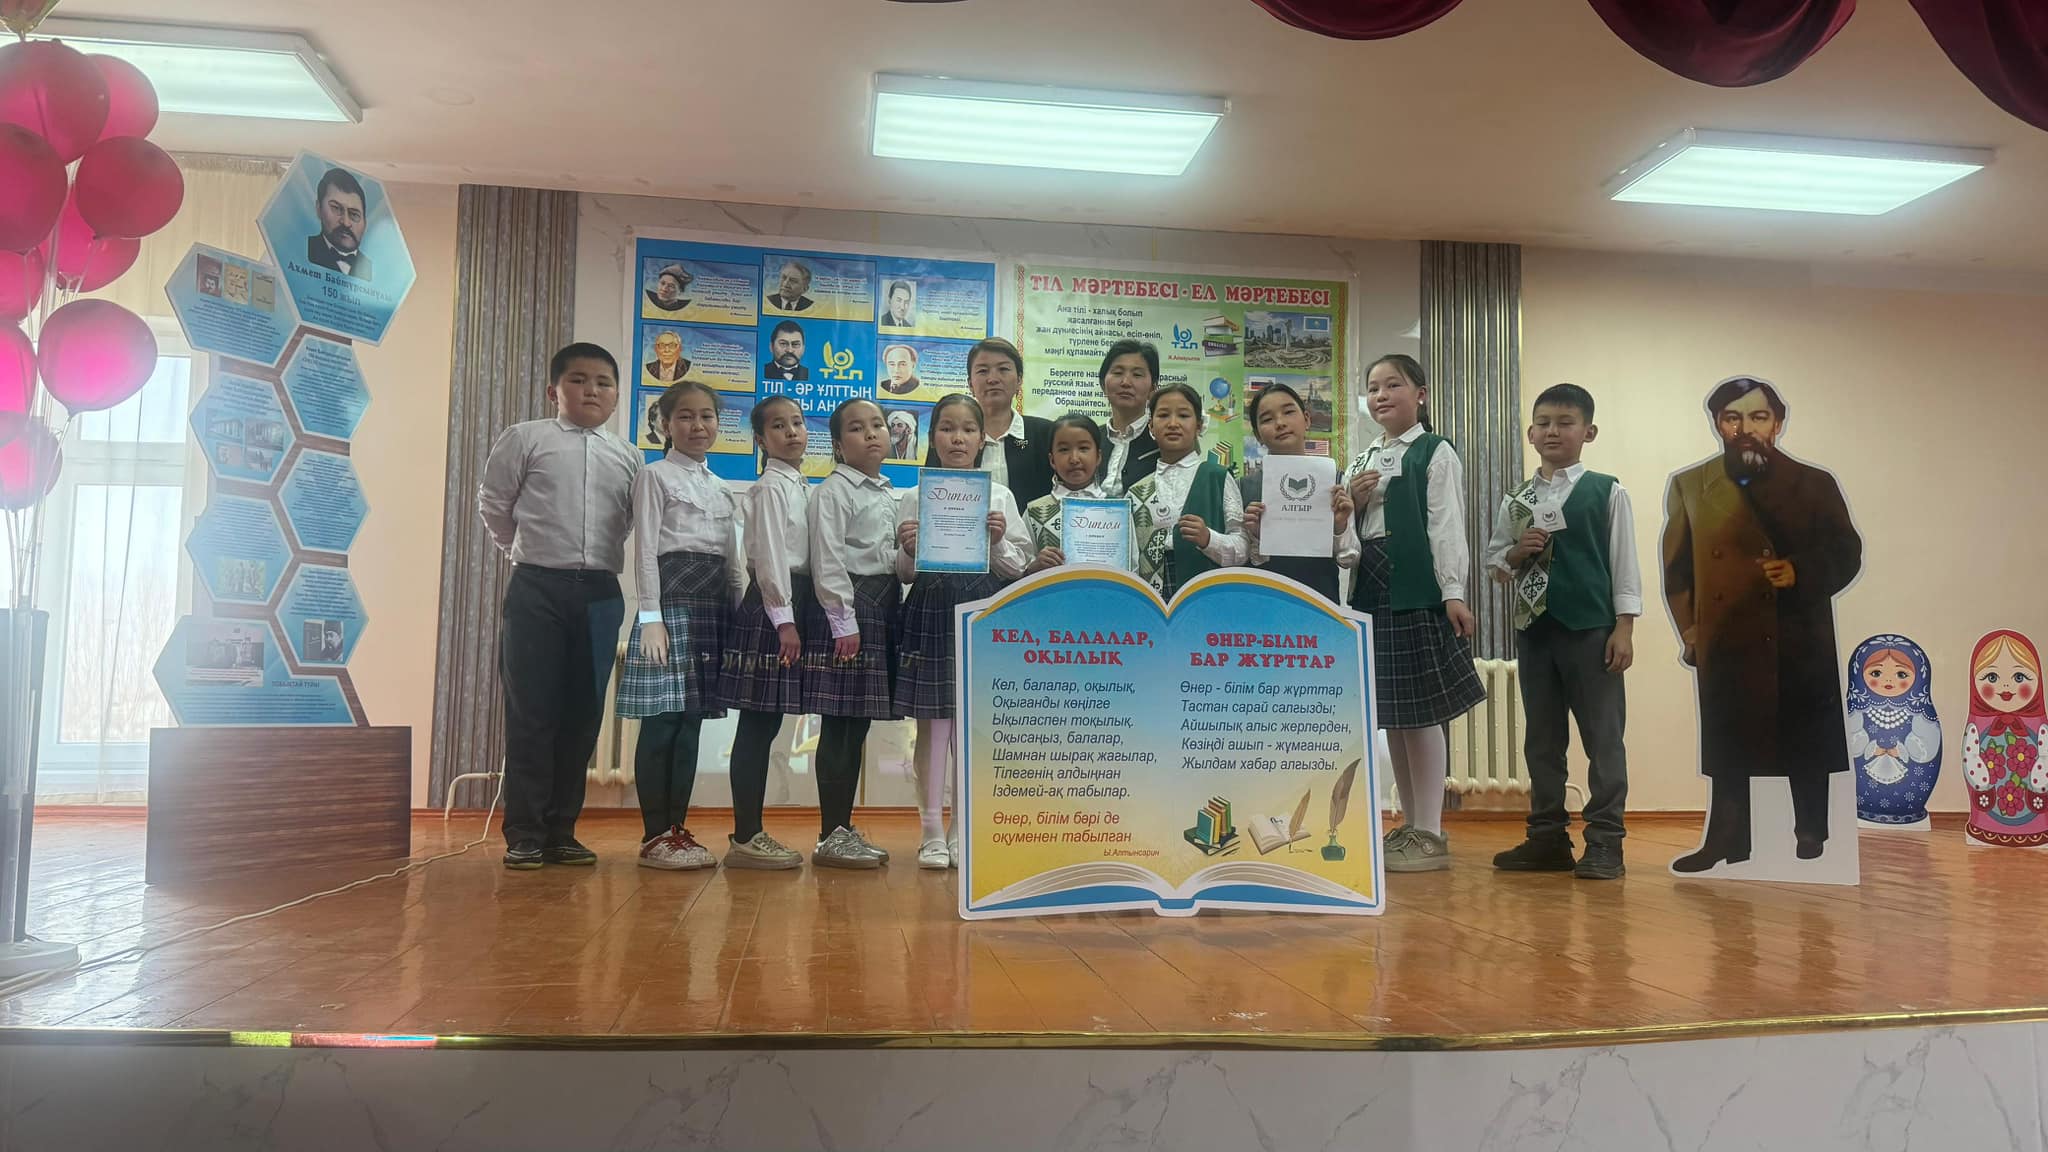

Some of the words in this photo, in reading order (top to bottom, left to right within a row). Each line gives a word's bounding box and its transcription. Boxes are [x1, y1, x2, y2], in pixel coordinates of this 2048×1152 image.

[288, 261, 321, 279] Ахмет
[322, 286, 338, 299] 150
[1030, 275, 1063, 292] ТІЛ
[1226, 286, 1330, 305] МӘРТЕБЕСІ
[1057, 305, 1072, 313] Ана
[1093, 308, 1117, 317] халық
[1118, 308, 1143, 317] болып
[1117, 319, 1133, 328] бері
[1069, 338, 1099, 347] түрлене
[1050, 368, 1084, 379] Берегите
[762, 381, 784, 393] ТІЛ
[795, 383, 814, 395] ӘР
[816, 384, 872, 400] ҰЛТТЫҢ
[1044, 378, 1074, 388] русский
[1075, 380, 1095, 388] язык
[1032, 388, 1077, 397] переданное
[1055, 397, 1106, 408] Обращайтесь
[927, 487, 982, 502] Диплом
[1069, 516, 1121, 530] Диплом
[991, 629, 1040, 646] КЕЛ,
[1048, 630, 1154, 648] БАЛАЛАР,
[1206, 632, 1318, 649] ӨНЕР-БІЛІМ
[1024, 649, 1123, 666] ОҚЫЛЫҚ
[1190, 652, 1229, 666] БАР
[992, 678, 1018, 692] Кел,
[1023, 679, 1079, 694] балалар,
[1084, 681, 1136, 694] оқылық,
[1180, 680, 1213, 695] Өнер
[1224, 681, 1254, 694] білім
[1258, 681, 1280, 696] бар
[992, 696, 1061, 710] Оқығанды
[1063, 697, 1111, 710] көңілге
[1181, 700, 1228, 712] Тастан
[1232, 701, 1268, 715] сарай
[1271, 702, 1336, 715] салғызды;
[992, 713, 1067, 727] Ықыласпен
[1180, 719, 1243, 733] Айшылық
[1246, 721, 1277, 732] алыс
[1281, 721, 1352, 735] жерлерден,
[992, 731, 1062, 745] Оқысаңыз,
[1067, 731, 1124, 746] балалар,
[1182, 737, 1225, 752] Көзіңді
[1228, 740, 1263, 751] ашып
[992, 748, 1046, 761] Шамнан
[1050, 751, 1094, 764] шырақ
[1097, 751, 1158, 765] жағылар,
[1182, 757, 1236, 770] Жылдам
[1240, 757, 1276, 772] хабар
[1280, 758, 1338, 770] алғызды.
[993, 766, 1054, 780] Тілегенің
[1057, 767, 1121, 780] алдыңнан
[993, 784, 1063, 799] Іздемей-ақ
[1066, 784, 1130, 799] табылар.
[993, 811, 1032, 827] Өнер,
[1036, 811, 1069, 824] білім
[1073, 811, 1100, 827] бәрі
[1104, 811, 1120, 824] де
[992, 832, 1058, 846] оқуменен
[1061, 829, 1132, 842] табылған
